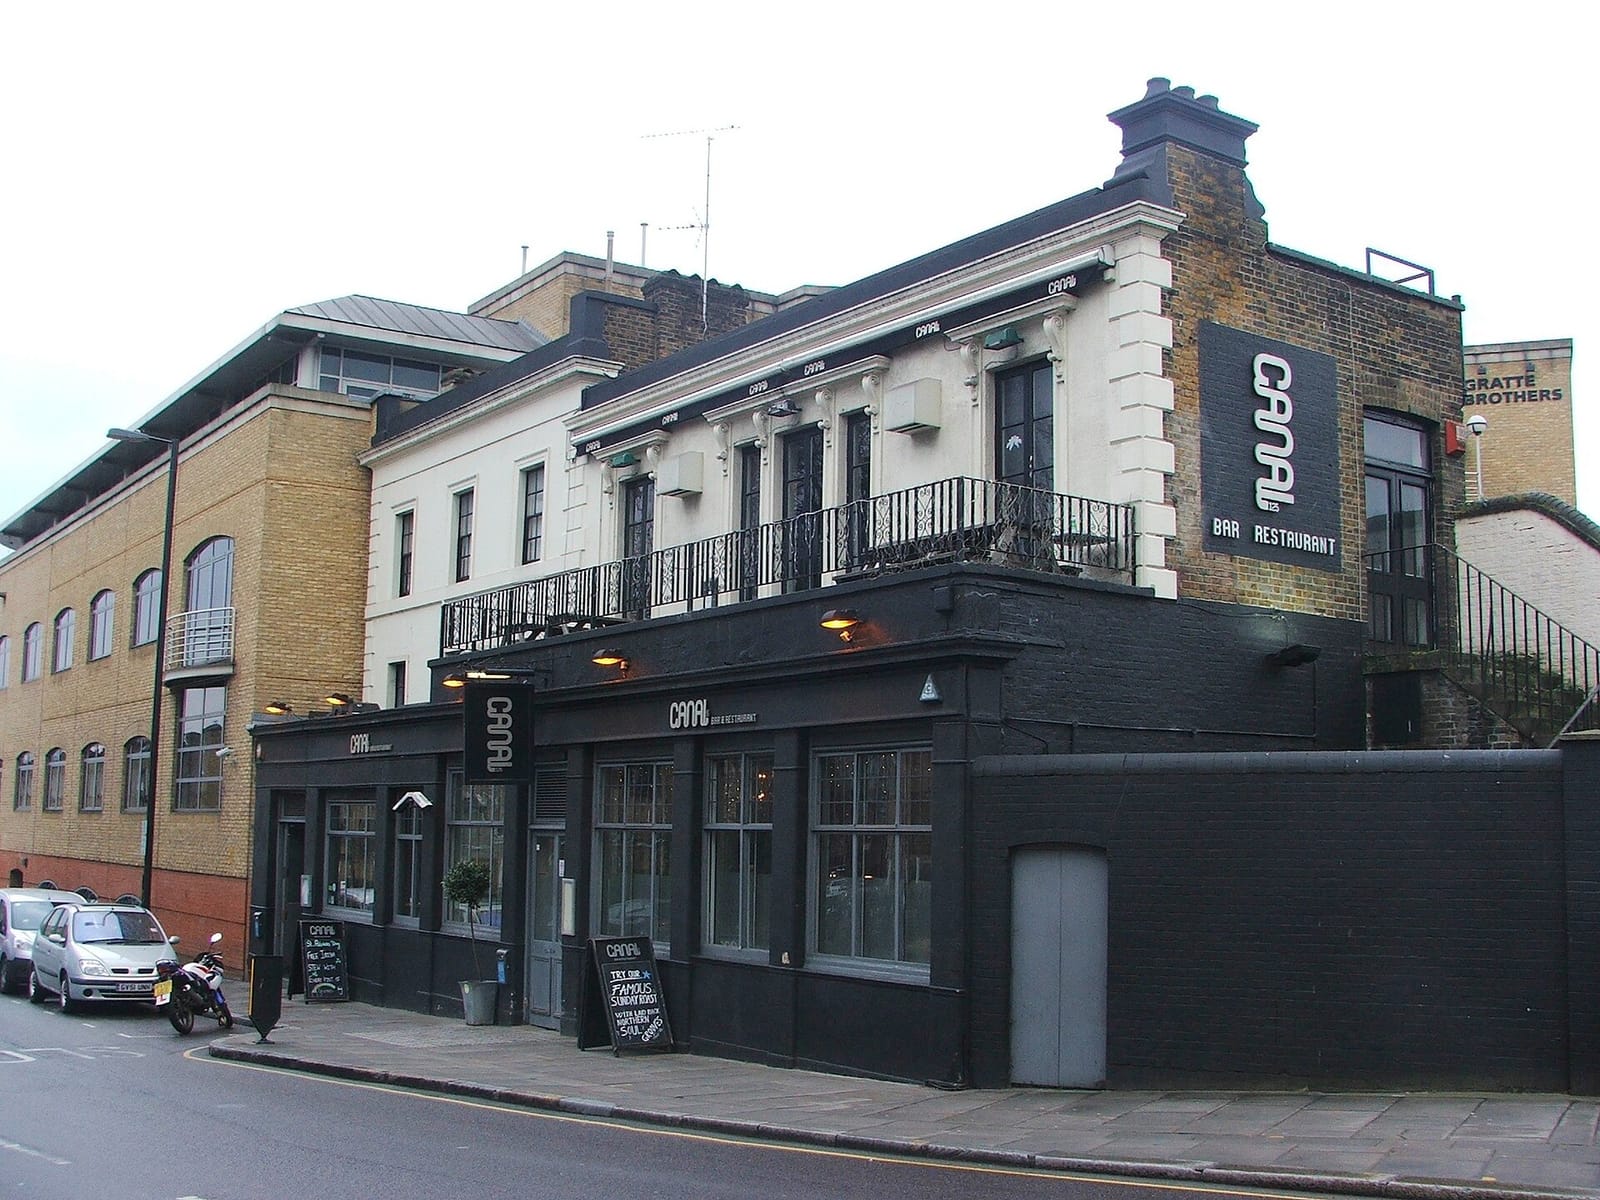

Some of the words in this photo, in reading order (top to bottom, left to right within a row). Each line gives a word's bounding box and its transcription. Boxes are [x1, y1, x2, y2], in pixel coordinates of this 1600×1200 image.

[1465, 374, 1536, 391] GRATTE
[1463, 388, 1563, 406] BROTHERS
[1254, 353, 1295, 511] CANAL
[1213, 517, 1240, 539] BAR
[1255, 525, 1336, 556] RESTAURANT
[670, 699, 709, 728] CANAL
[487, 696, 513, 773] CANAL
[606, 943, 641, 957] CANAL
[610, 970, 626, 979] TRY
[611, 982, 652, 995] FAMOUS
